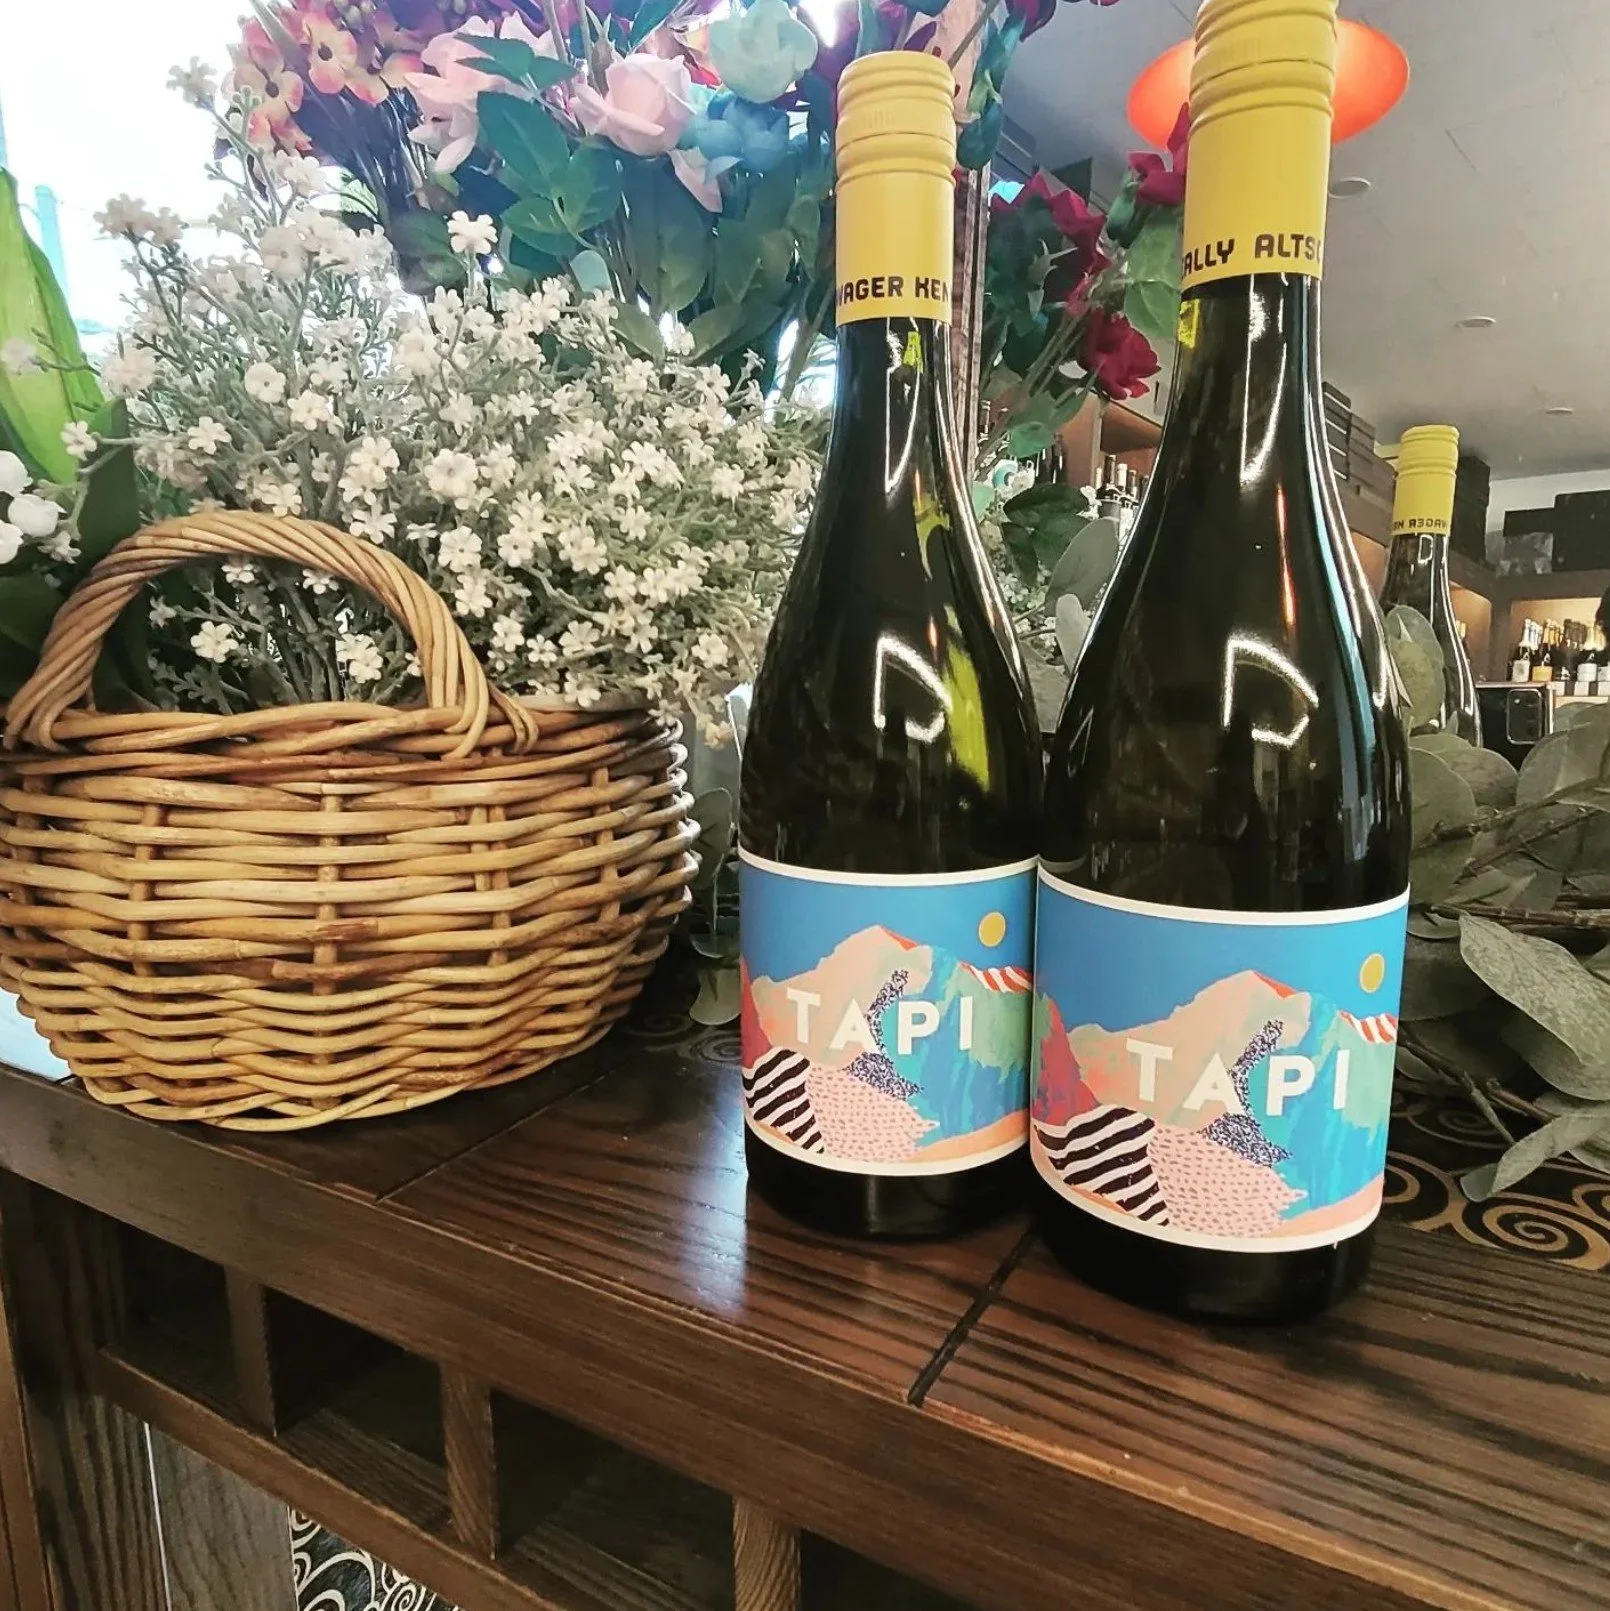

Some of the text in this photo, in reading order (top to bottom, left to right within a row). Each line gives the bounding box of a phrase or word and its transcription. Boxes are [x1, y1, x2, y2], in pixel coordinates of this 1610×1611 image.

[1182, 238, 1235, 278] ALLY
[786, 987, 974, 1055] TAPI
[1125, 1037, 1350, 1116] TAPI
